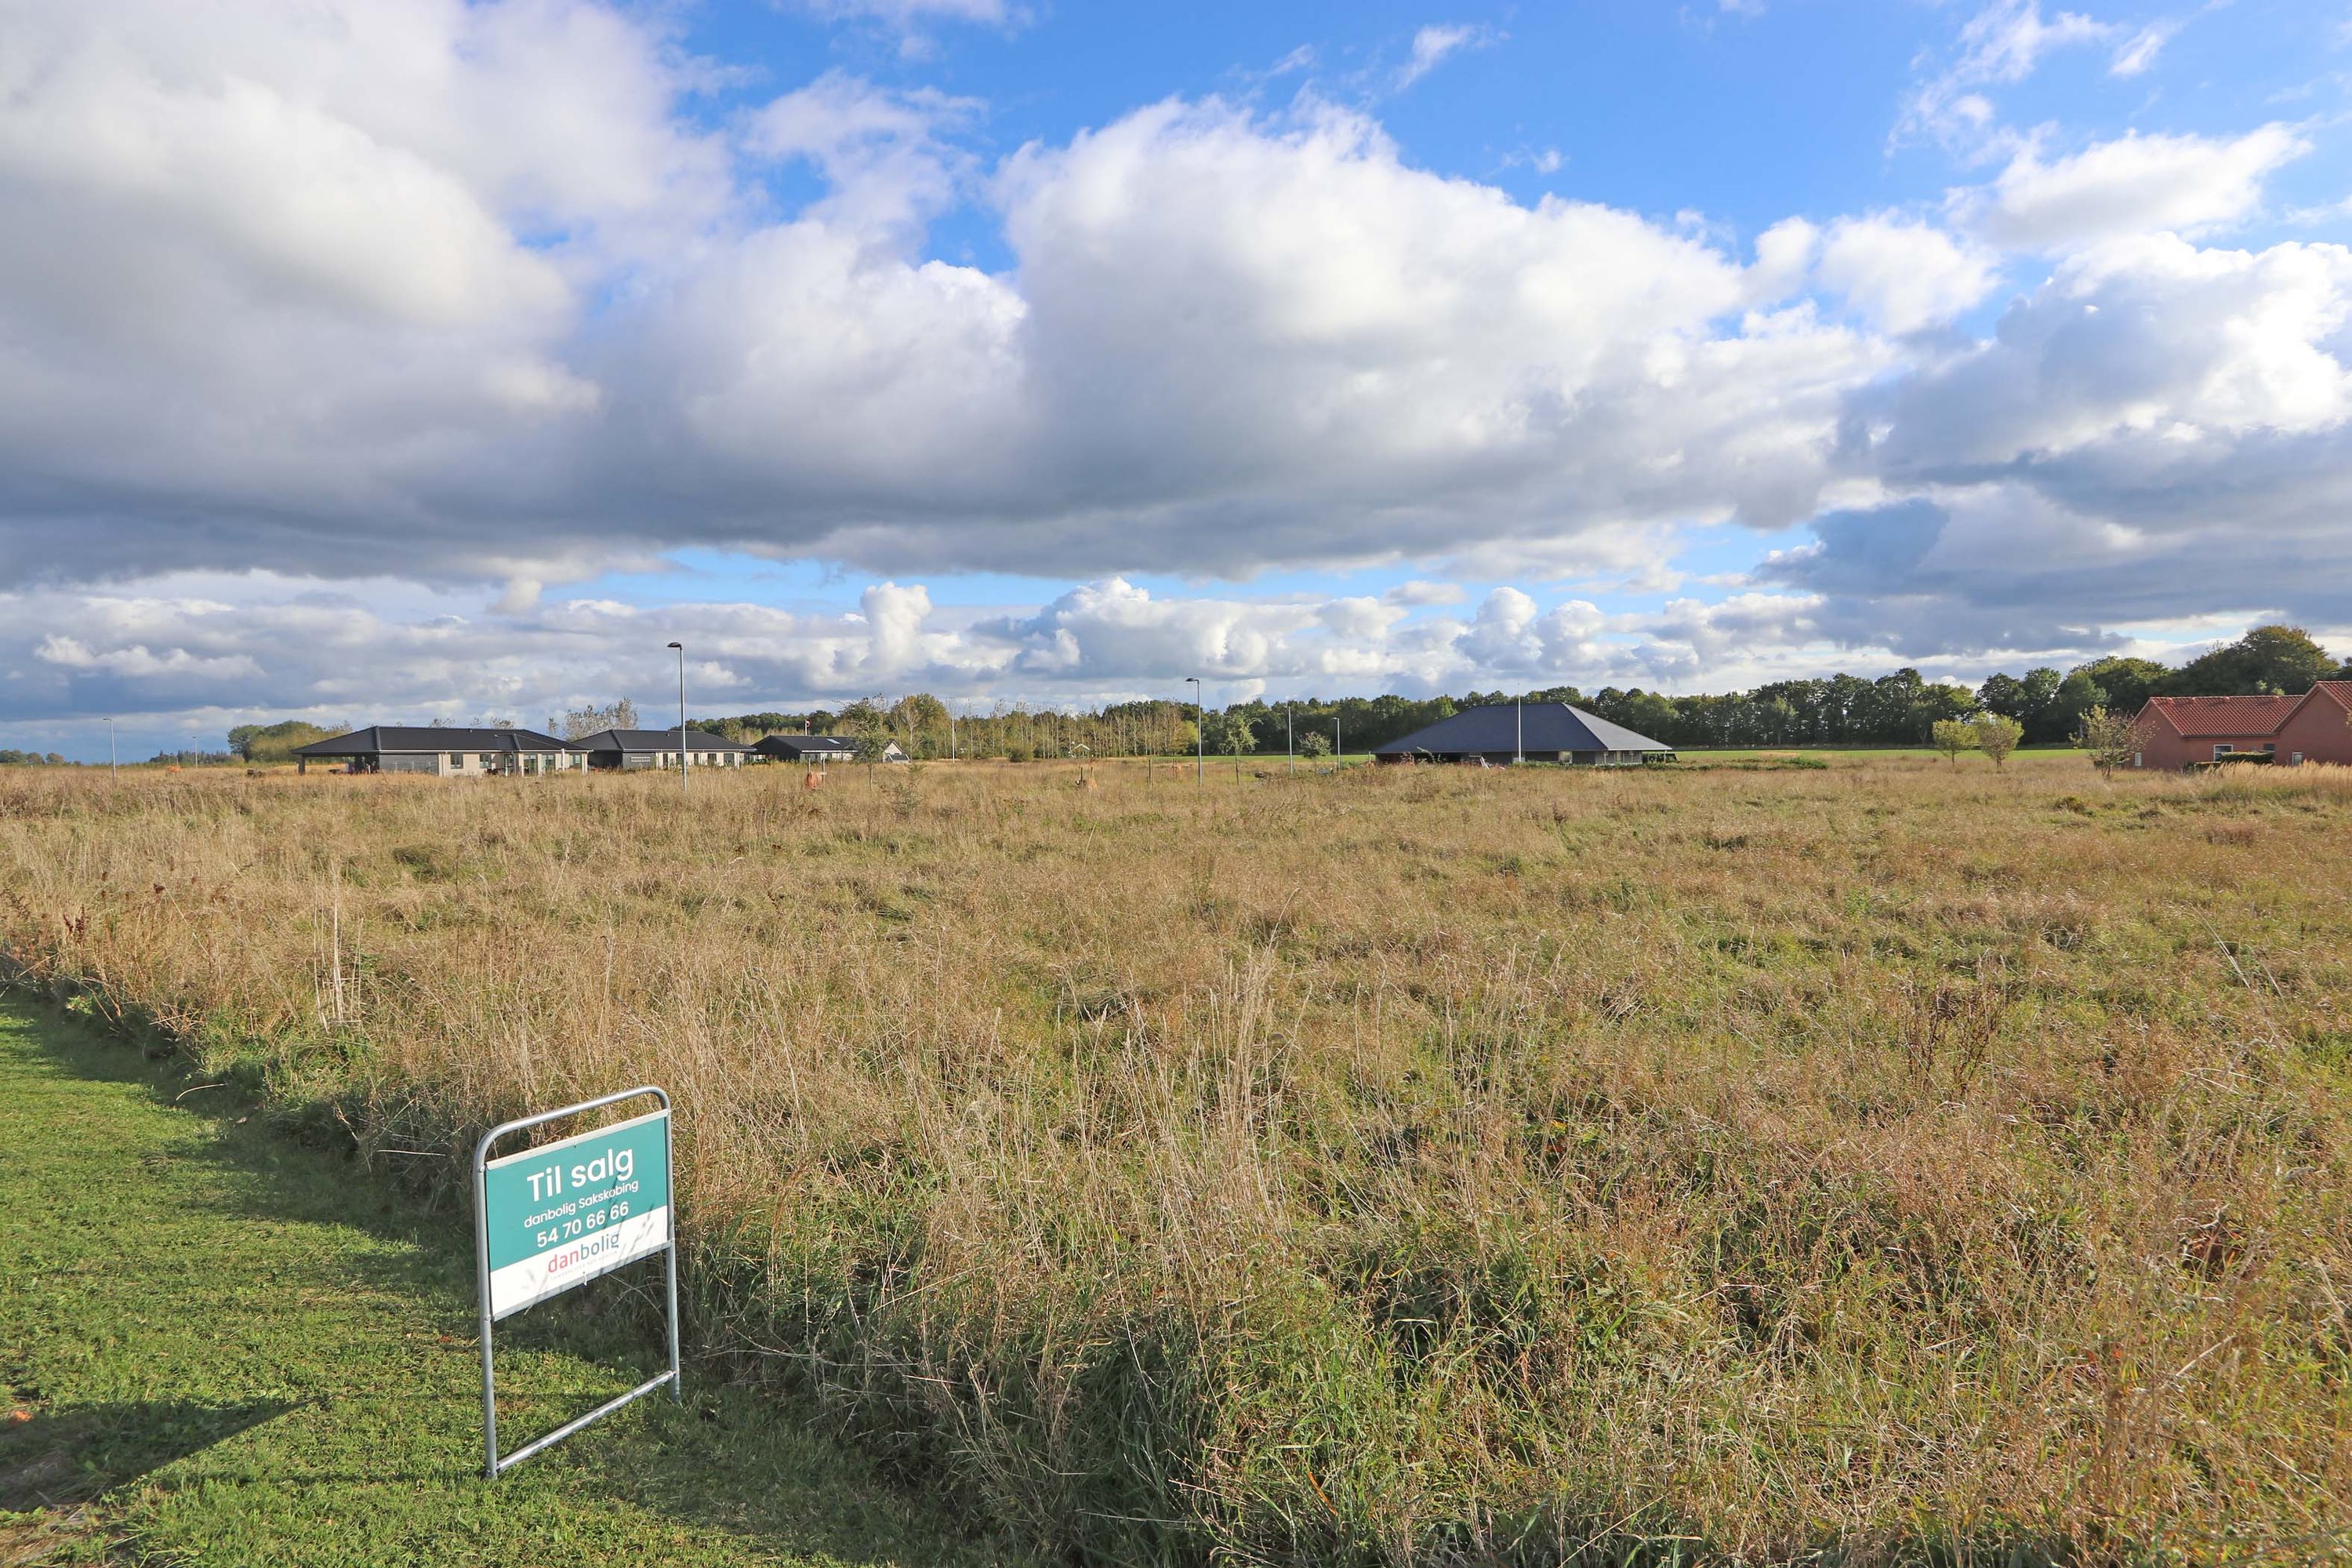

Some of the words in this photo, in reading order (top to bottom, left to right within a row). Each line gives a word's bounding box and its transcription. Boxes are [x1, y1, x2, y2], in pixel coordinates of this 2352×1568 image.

[527, 1165, 561, 1202] Til
[571, 1148, 633, 1188] salg
[524, 1202, 576, 1228] danbolig
[537, 1227, 559, 1247] 54
[562, 1218, 582, 1239] 70
[586, 1210, 606, 1229] 66
[610, 1201, 629, 1220] 66
[548, 1232, 619, 1272] danbolig
